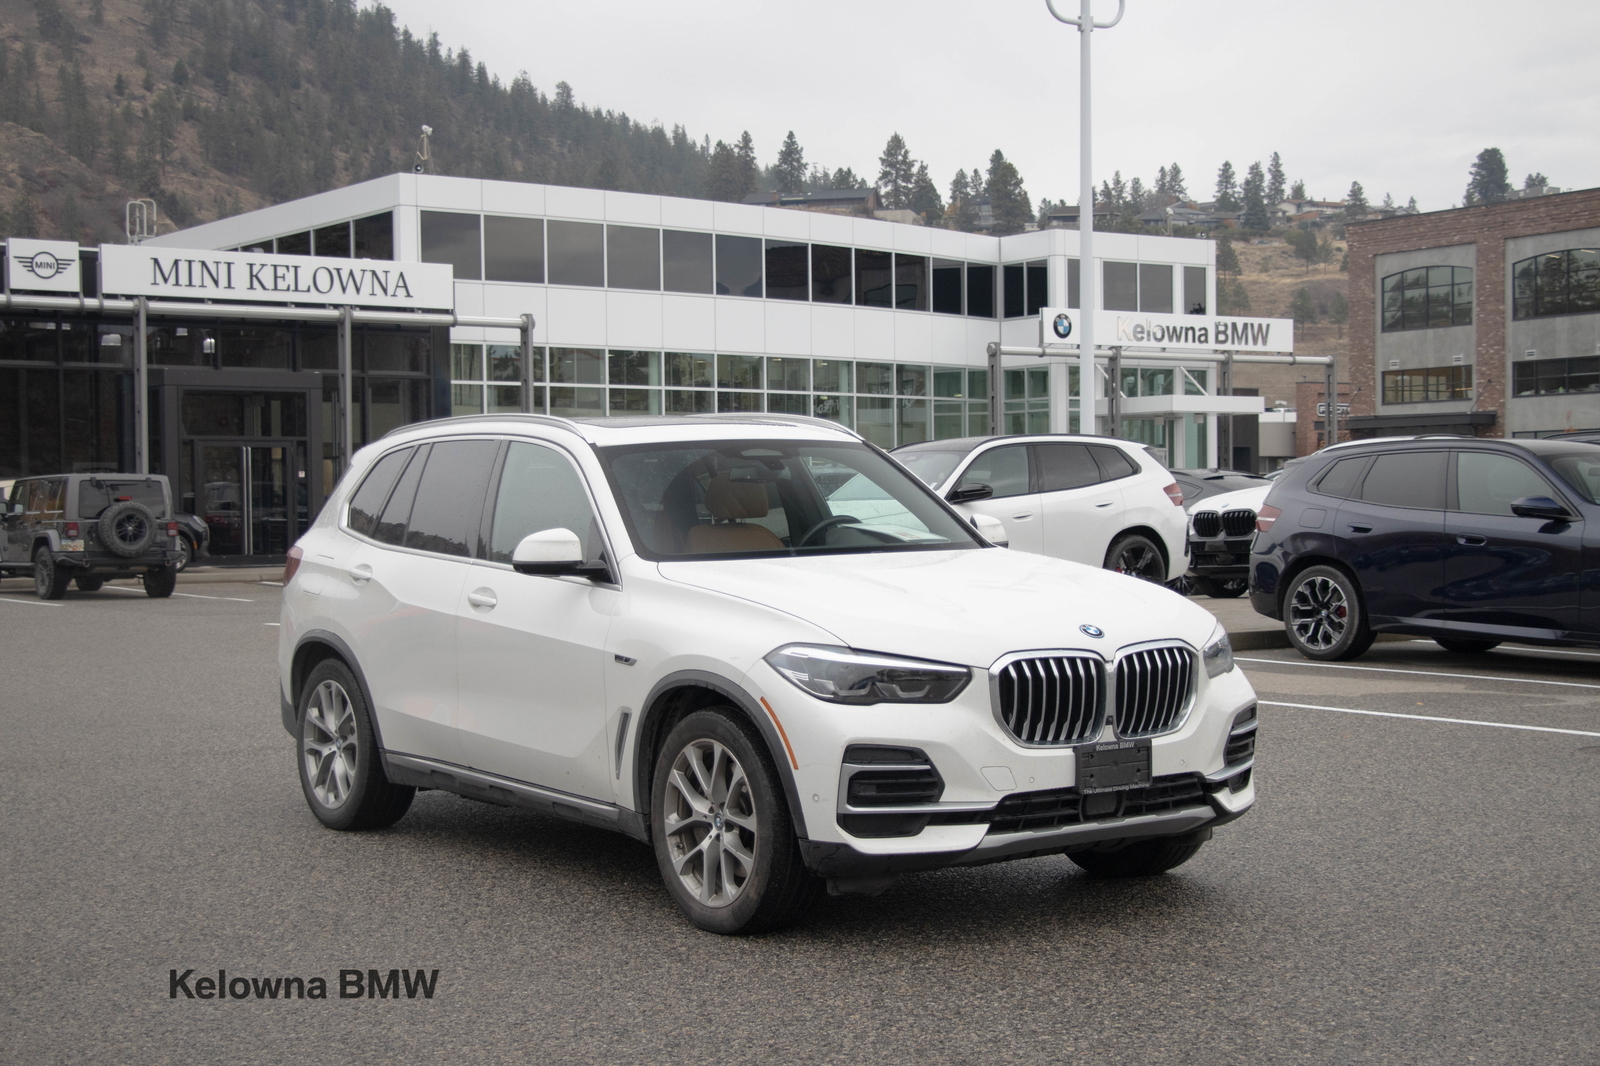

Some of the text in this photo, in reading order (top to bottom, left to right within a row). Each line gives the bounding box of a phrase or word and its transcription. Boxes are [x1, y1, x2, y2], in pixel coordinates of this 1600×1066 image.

[35, 261, 56, 270] MINI
[150, 257, 414, 298] MINI KELOWNA
[1116, 316, 1271, 347] Kelowna BMW
[1119, 741, 1135, 749] BMW
